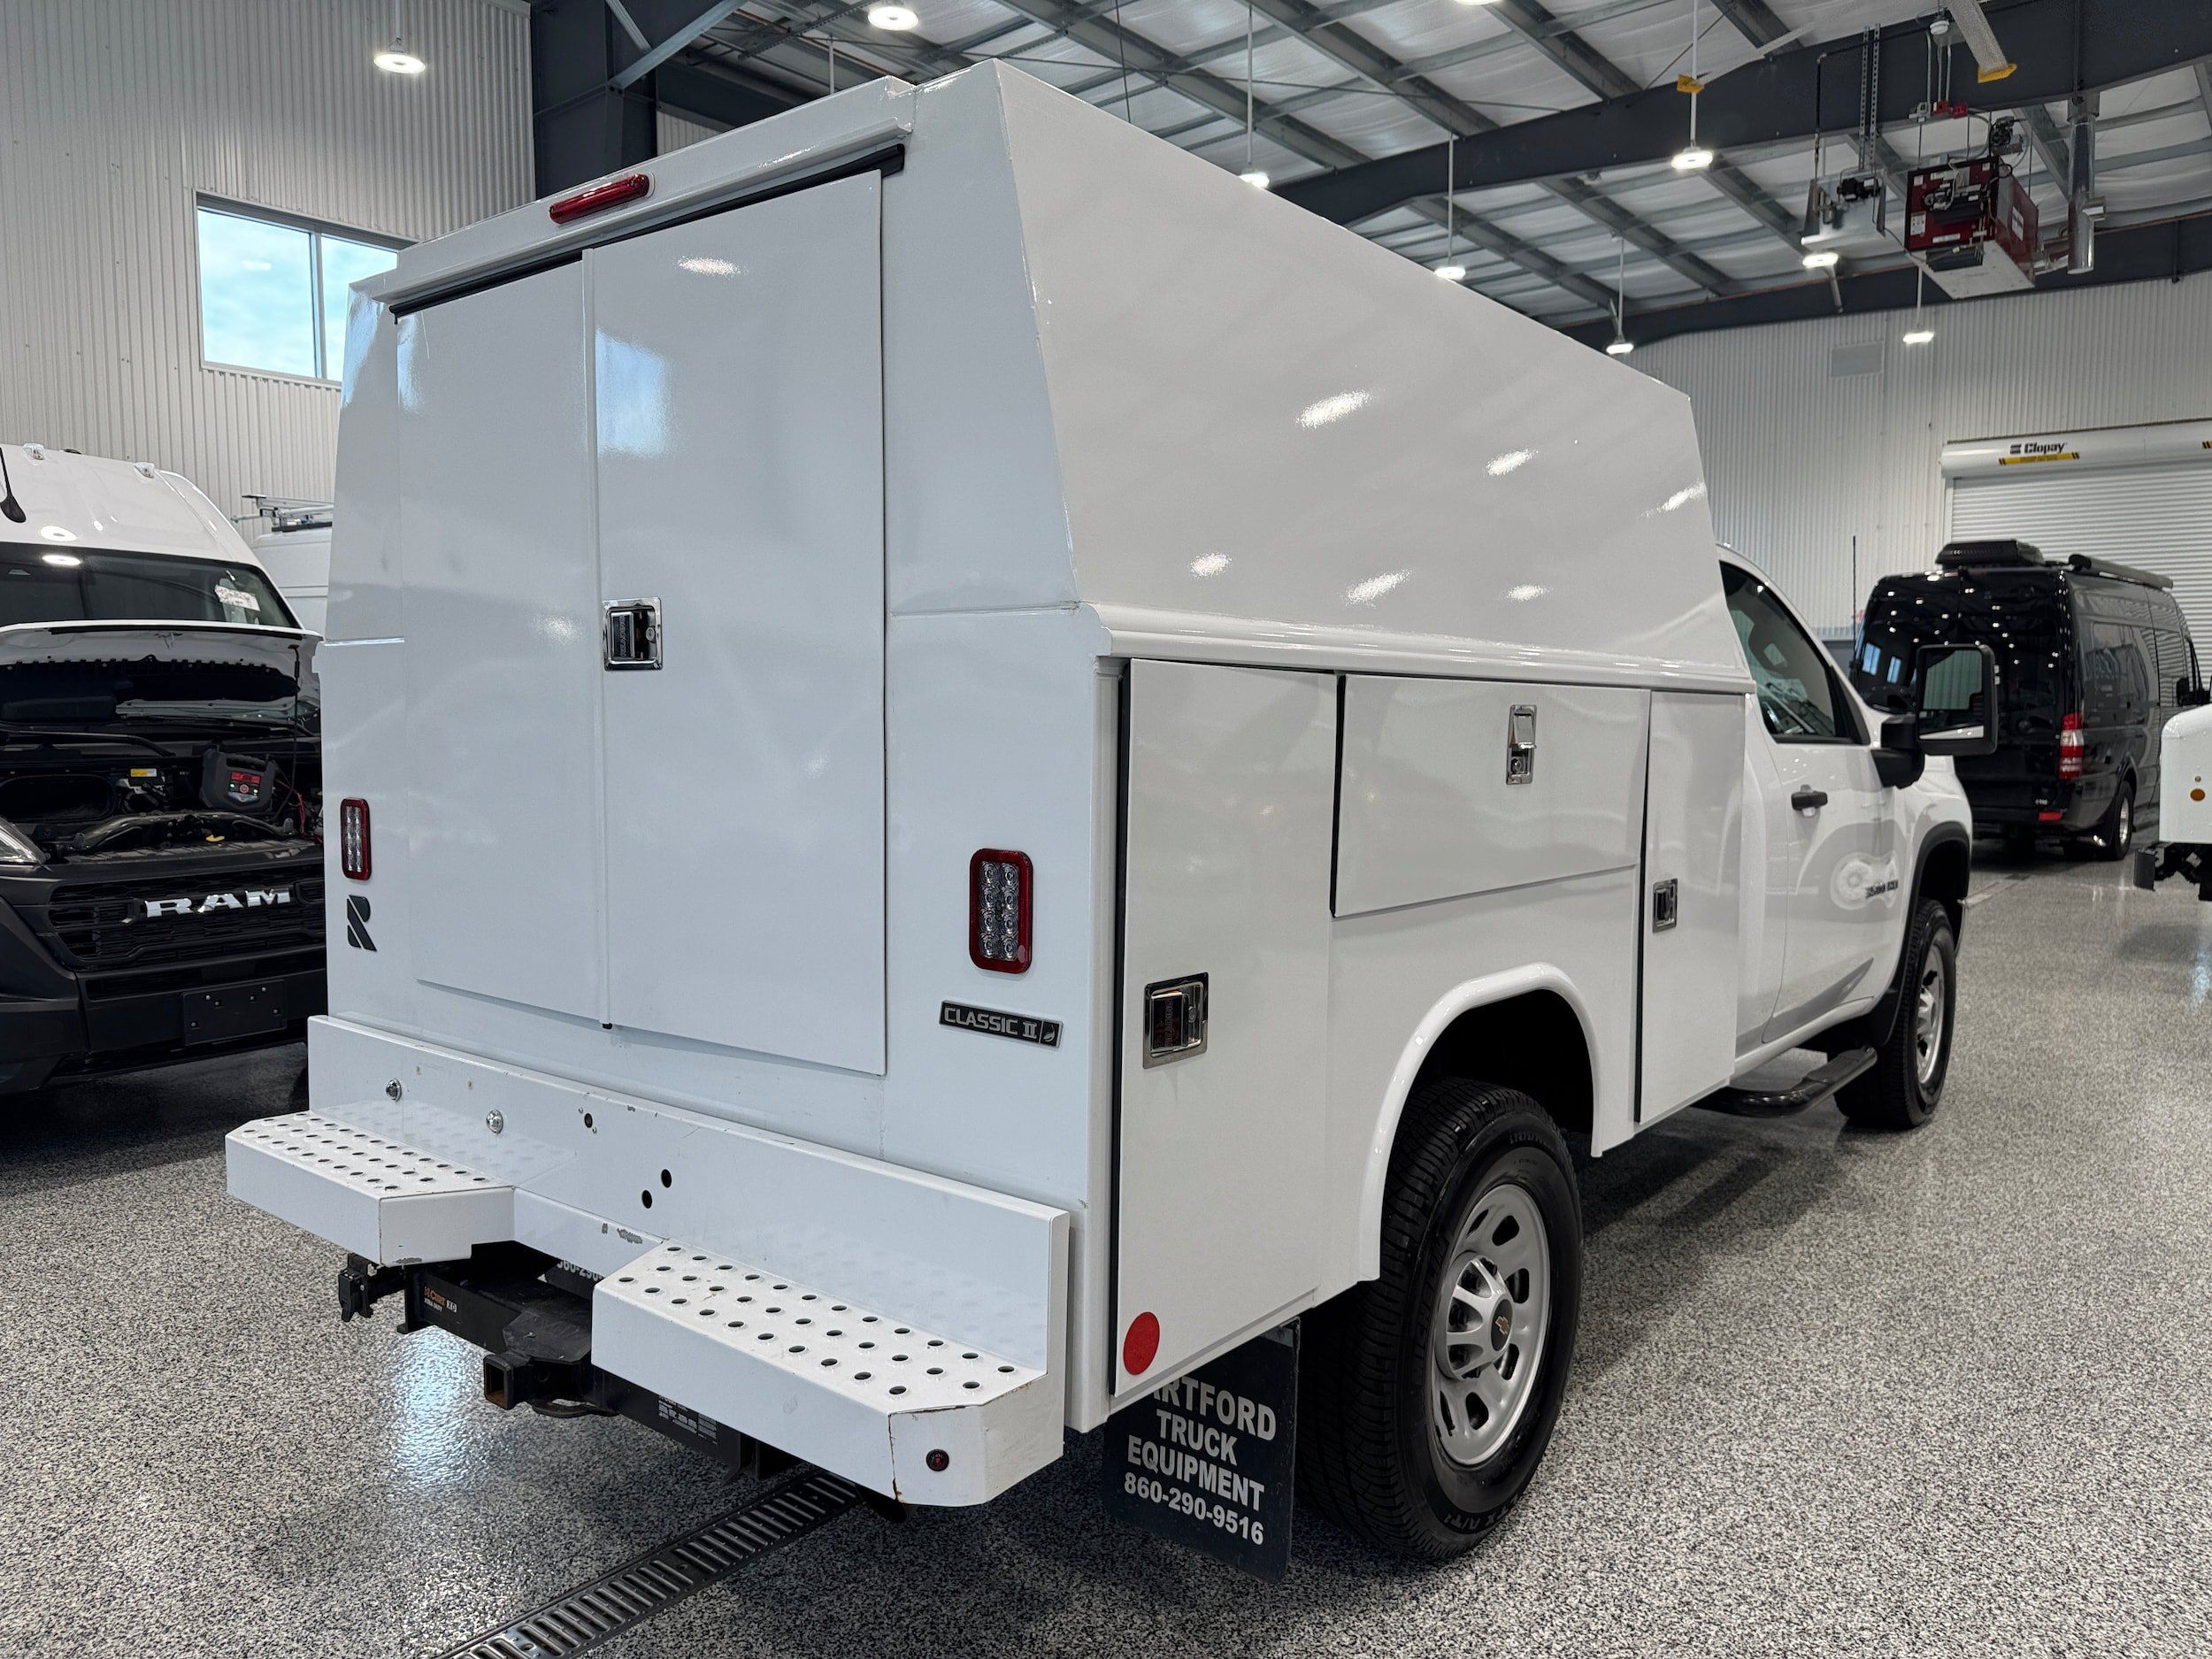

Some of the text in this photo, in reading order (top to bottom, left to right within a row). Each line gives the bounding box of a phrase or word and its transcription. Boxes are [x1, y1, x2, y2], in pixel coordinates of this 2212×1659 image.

[2024, 442, 2064, 454] Clopay
[144, 887, 291, 918] RAM
[944, 1007, 1038, 1040] CLASSIC II
[1153, 1376, 1277, 1441] RTFORD
[1156, 1409, 1238, 1466] TRUCK
[1127, 1434, 1265, 1512] EQUIPMENT
[1124, 1471, 1264, 1546] 860-290-9516
